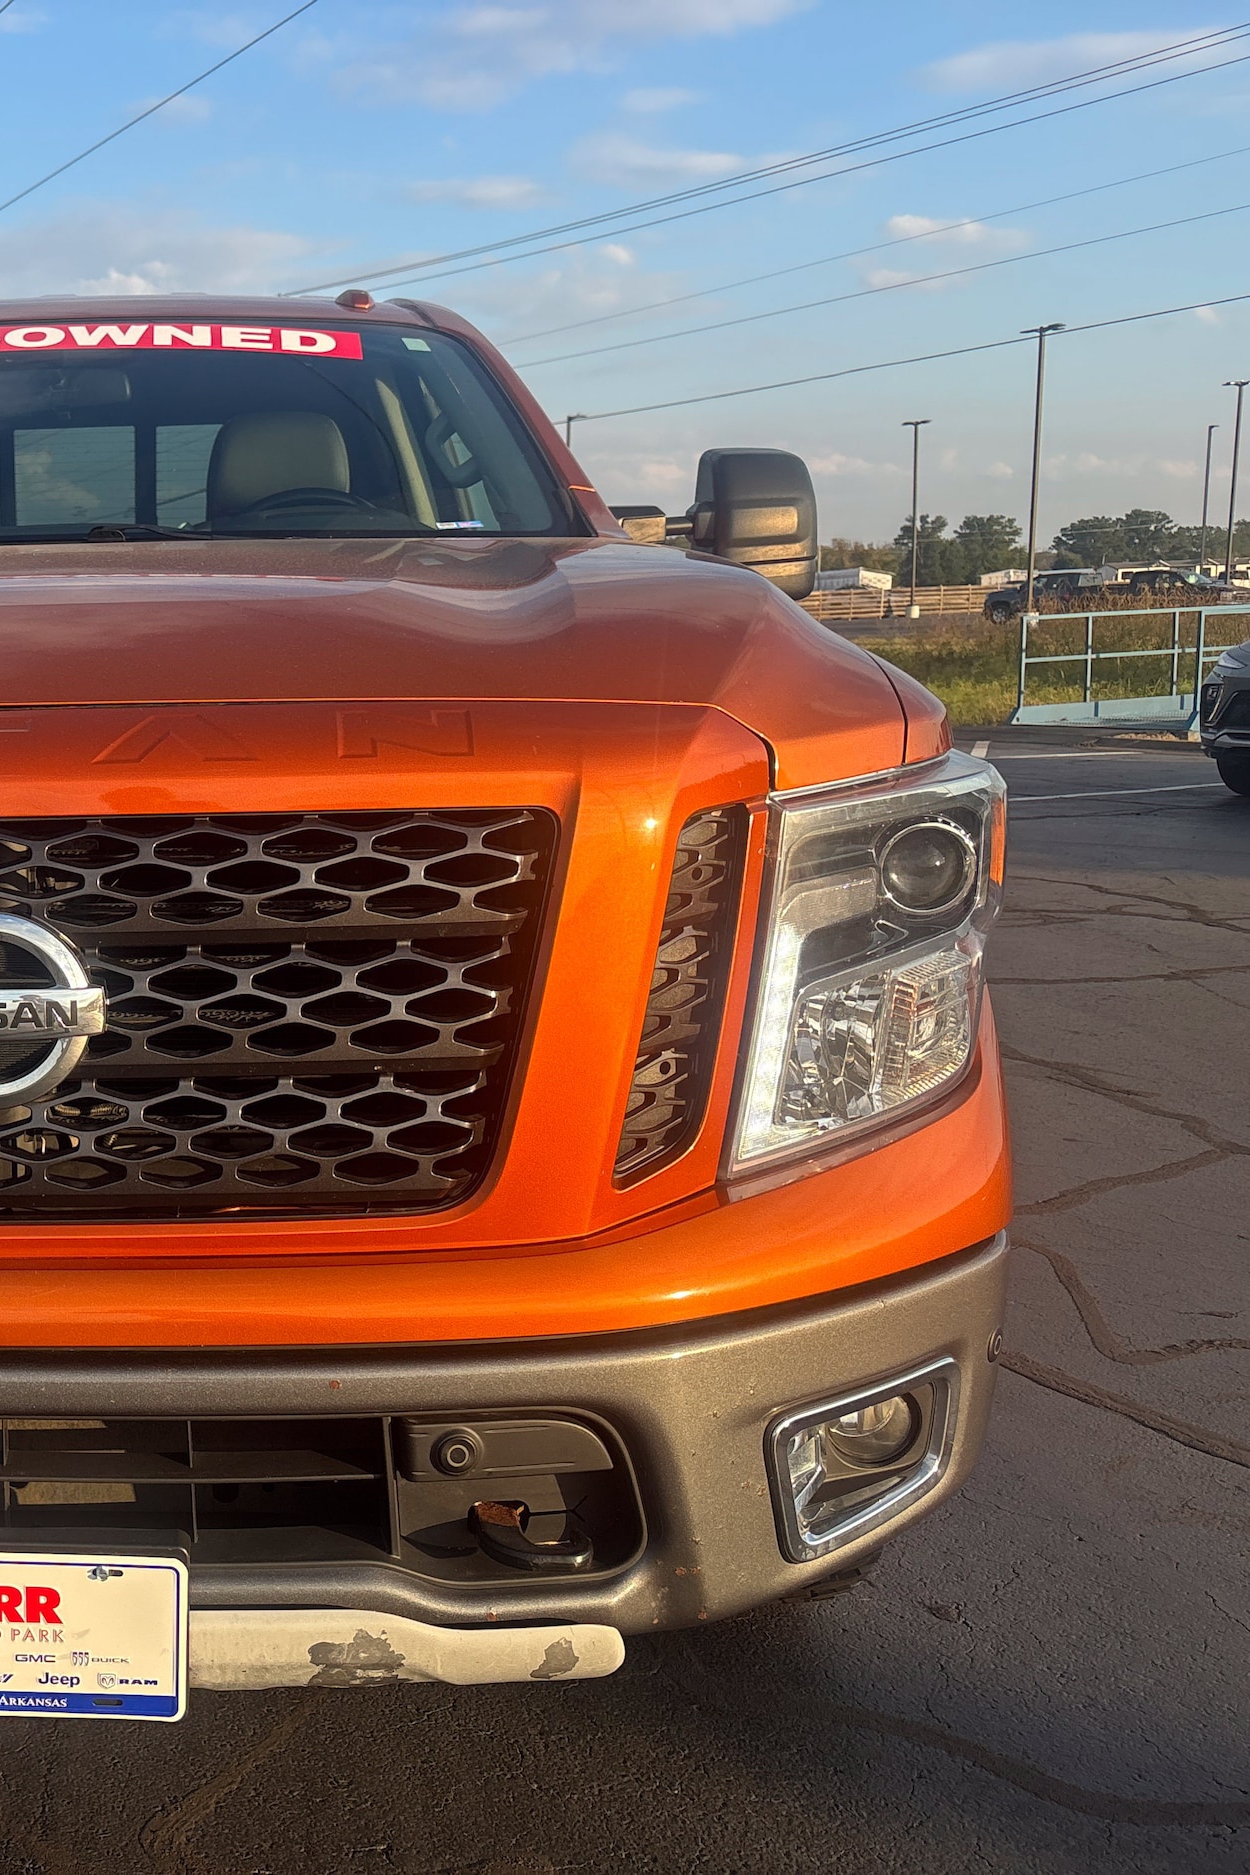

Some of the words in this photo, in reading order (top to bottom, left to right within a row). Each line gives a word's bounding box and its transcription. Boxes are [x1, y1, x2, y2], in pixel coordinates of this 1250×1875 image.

[10, 1627, 64, 1643] PARK
[15, 1654, 56, 1663] GMC
[38, 1672, 81, 1687] Jeep
[118, 1678, 158, 1686] RAM
